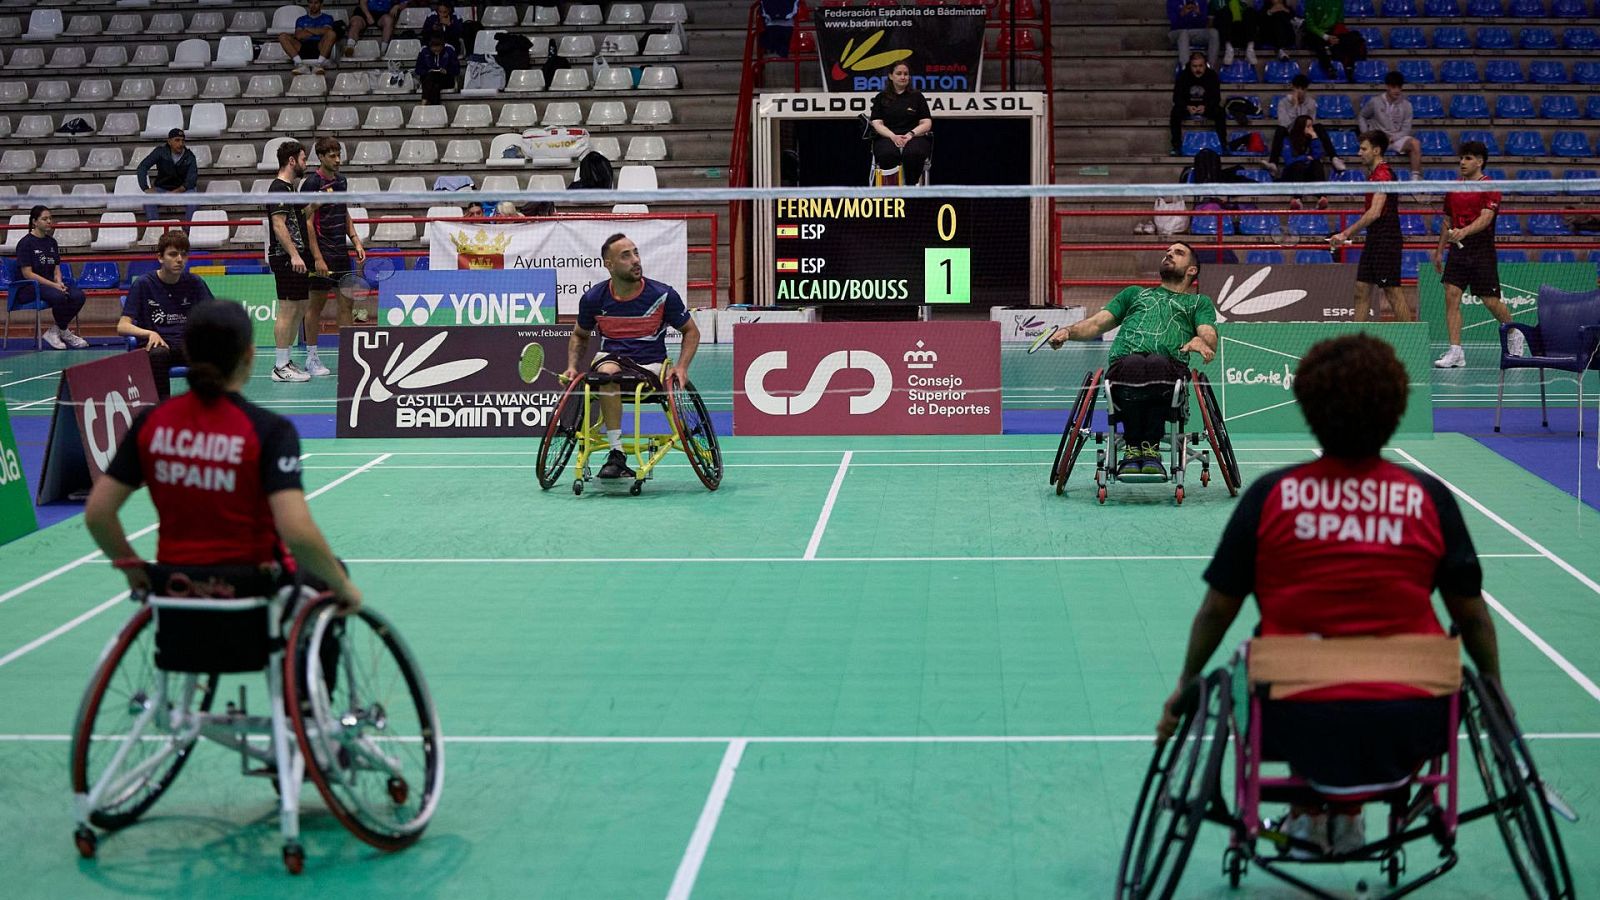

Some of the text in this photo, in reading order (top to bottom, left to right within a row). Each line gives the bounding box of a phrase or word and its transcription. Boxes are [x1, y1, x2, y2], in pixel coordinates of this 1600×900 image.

[825, 9, 876, 17] Federación
[879, 8, 921, 17] Española
[924, 8, 935, 16] de
[825, 18, 912, 28] www.badminton.es
[772, 97, 874, 112] TOLDO
[777, 198, 906, 219] FERNA/MOTER
[937, 203, 957, 242] 0
[801, 224, 825, 240] ESP
[513, 254, 602, 270] Ayuntamien
[801, 258, 825, 274] ESP
[939, 258, 952, 295] 1
[777, 279, 909, 300] ALCAID/BOUSS
[450, 292, 546, 324] YONEX
[744, 350, 893, 415] CSD
[908, 374, 963, 389] Consejo
[1227, 368, 1241, 384] El
[1243, 368, 1281, 384] Corte
[396, 394, 464, 407] CASTILLA
[475, 394, 492, 406] LA
[496, 393, 561, 406] MANCHA
[908, 388, 966, 403] Superior
[908, 403, 990, 417] de Deportes
[150, 426, 245, 464] ALCAIDE
[154, 459, 237, 493] SPAIN
[1280, 476, 1424, 520] BOUSSIER
[1294, 511, 1404, 545] SPAIN
